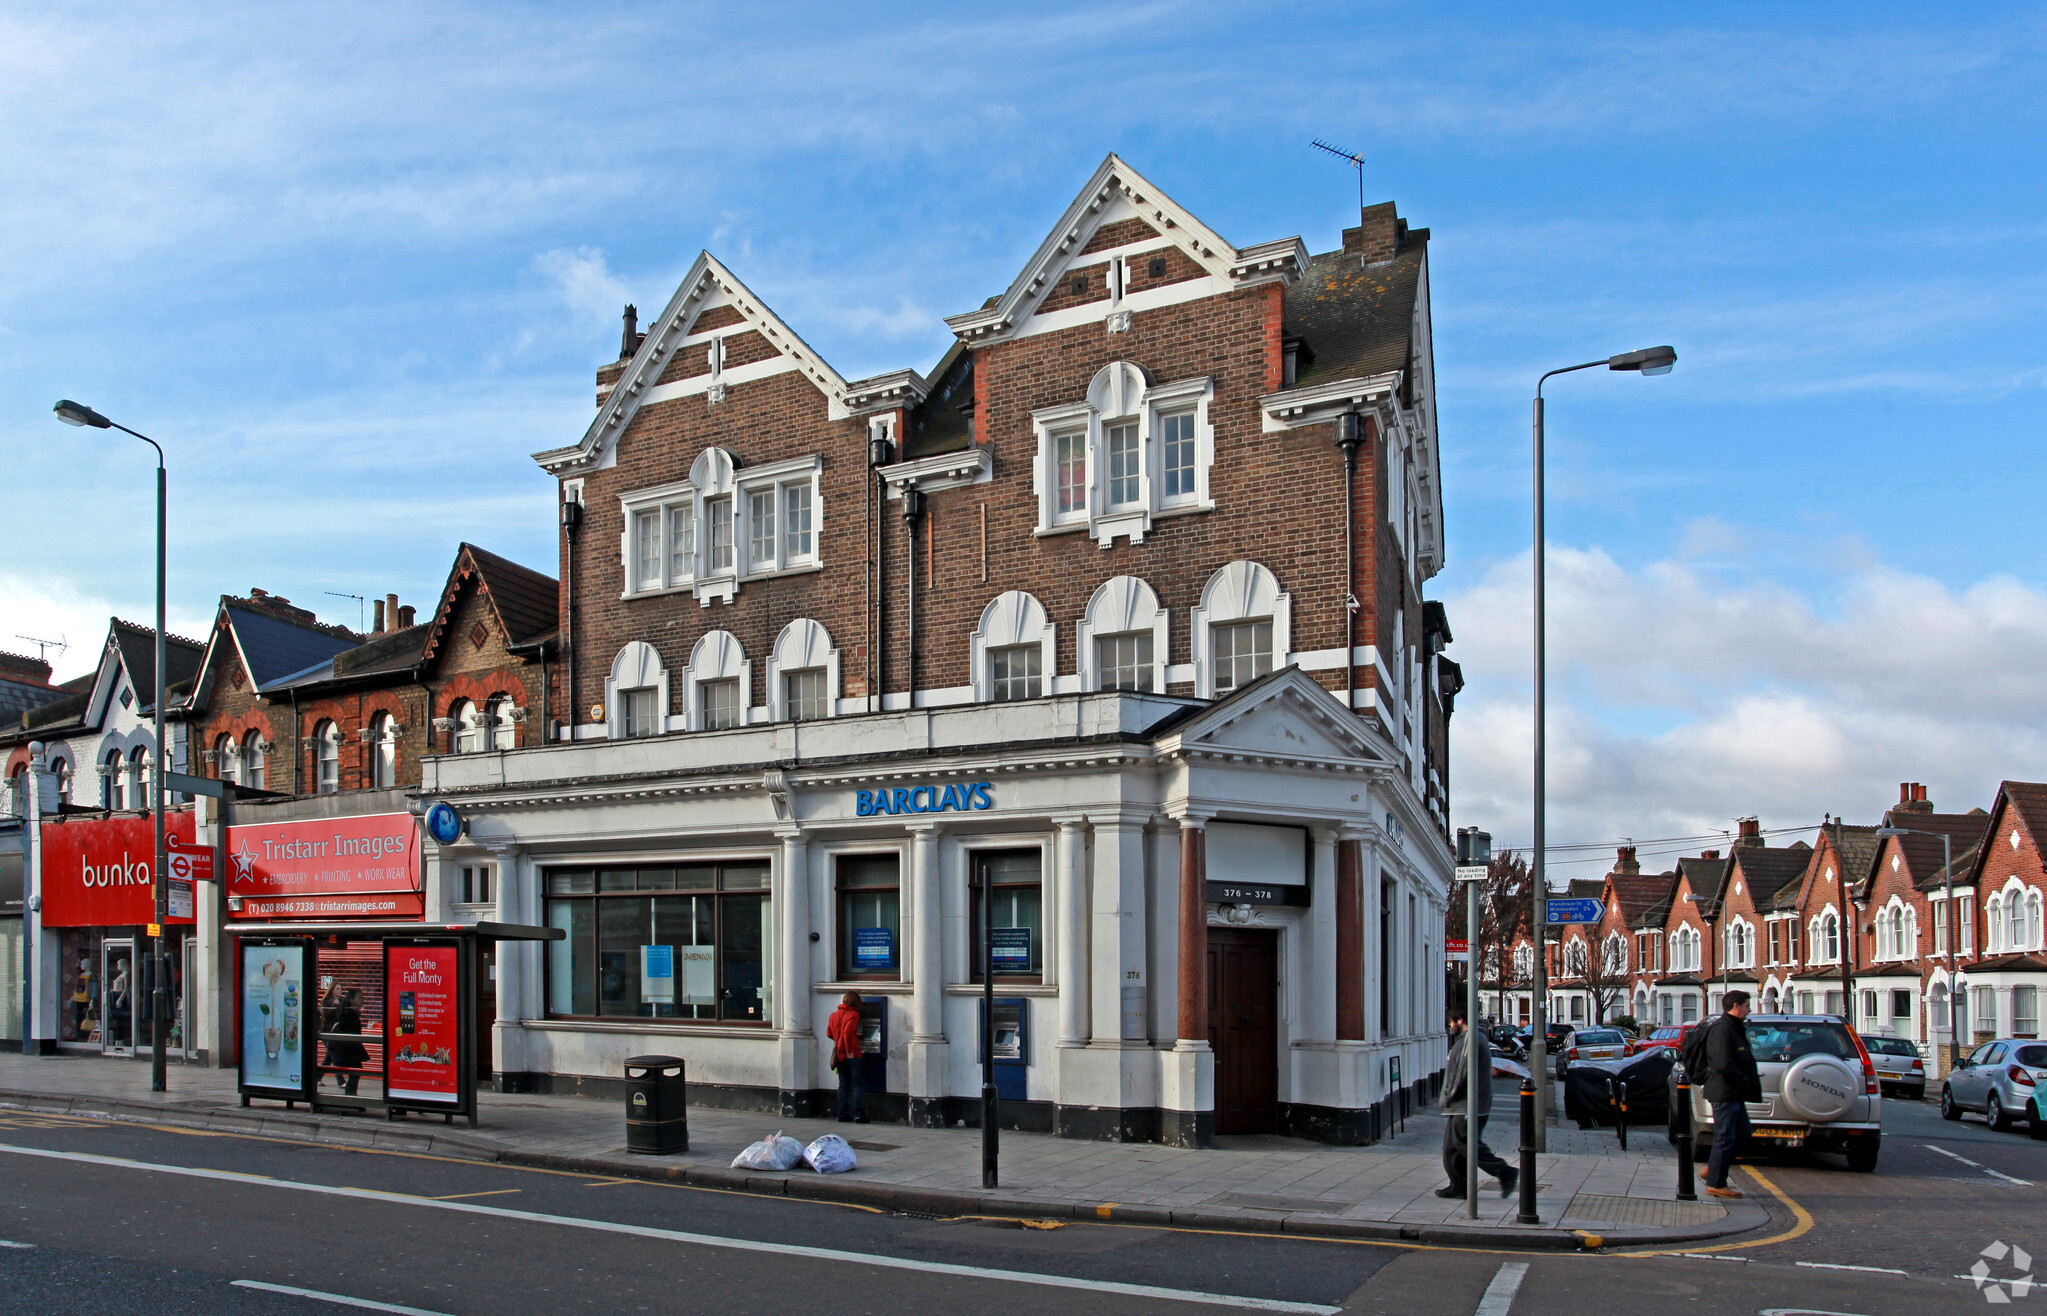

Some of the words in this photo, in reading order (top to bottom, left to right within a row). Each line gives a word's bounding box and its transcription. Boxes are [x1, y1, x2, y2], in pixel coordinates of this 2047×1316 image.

[856, 782, 992, 816] BARCLAYS
[168, 834, 178, 848] C
[263, 833, 329, 861] Tristarr
[334, 834, 405, 860] Images
[82, 851, 151, 888] bunka
[321, 870, 351, 883] PRINTING
[364, 868, 384, 881] WORK
[385, 867, 406, 880] WEAR
[269, 872, 308, 886] EMBROIDERY
[1223, 888, 1241, 898] 376
[1254, 890, 1272, 899] 378
[248, 903, 260, 915] (T)
[260, 903, 275, 913] 020
[275, 902, 294, 913] 8946
[295, 901, 315, 912] 7338
[320, 900, 396, 912] tristarrimages.com
[409, 958, 423, 970] Get
[424, 958, 437, 970] the
[403, 971, 417, 983] Full
[418, 971, 442, 986] Monty
[1126, 971, 1141, 980] 376
[1800, 1077, 1846, 1099] HONDA
